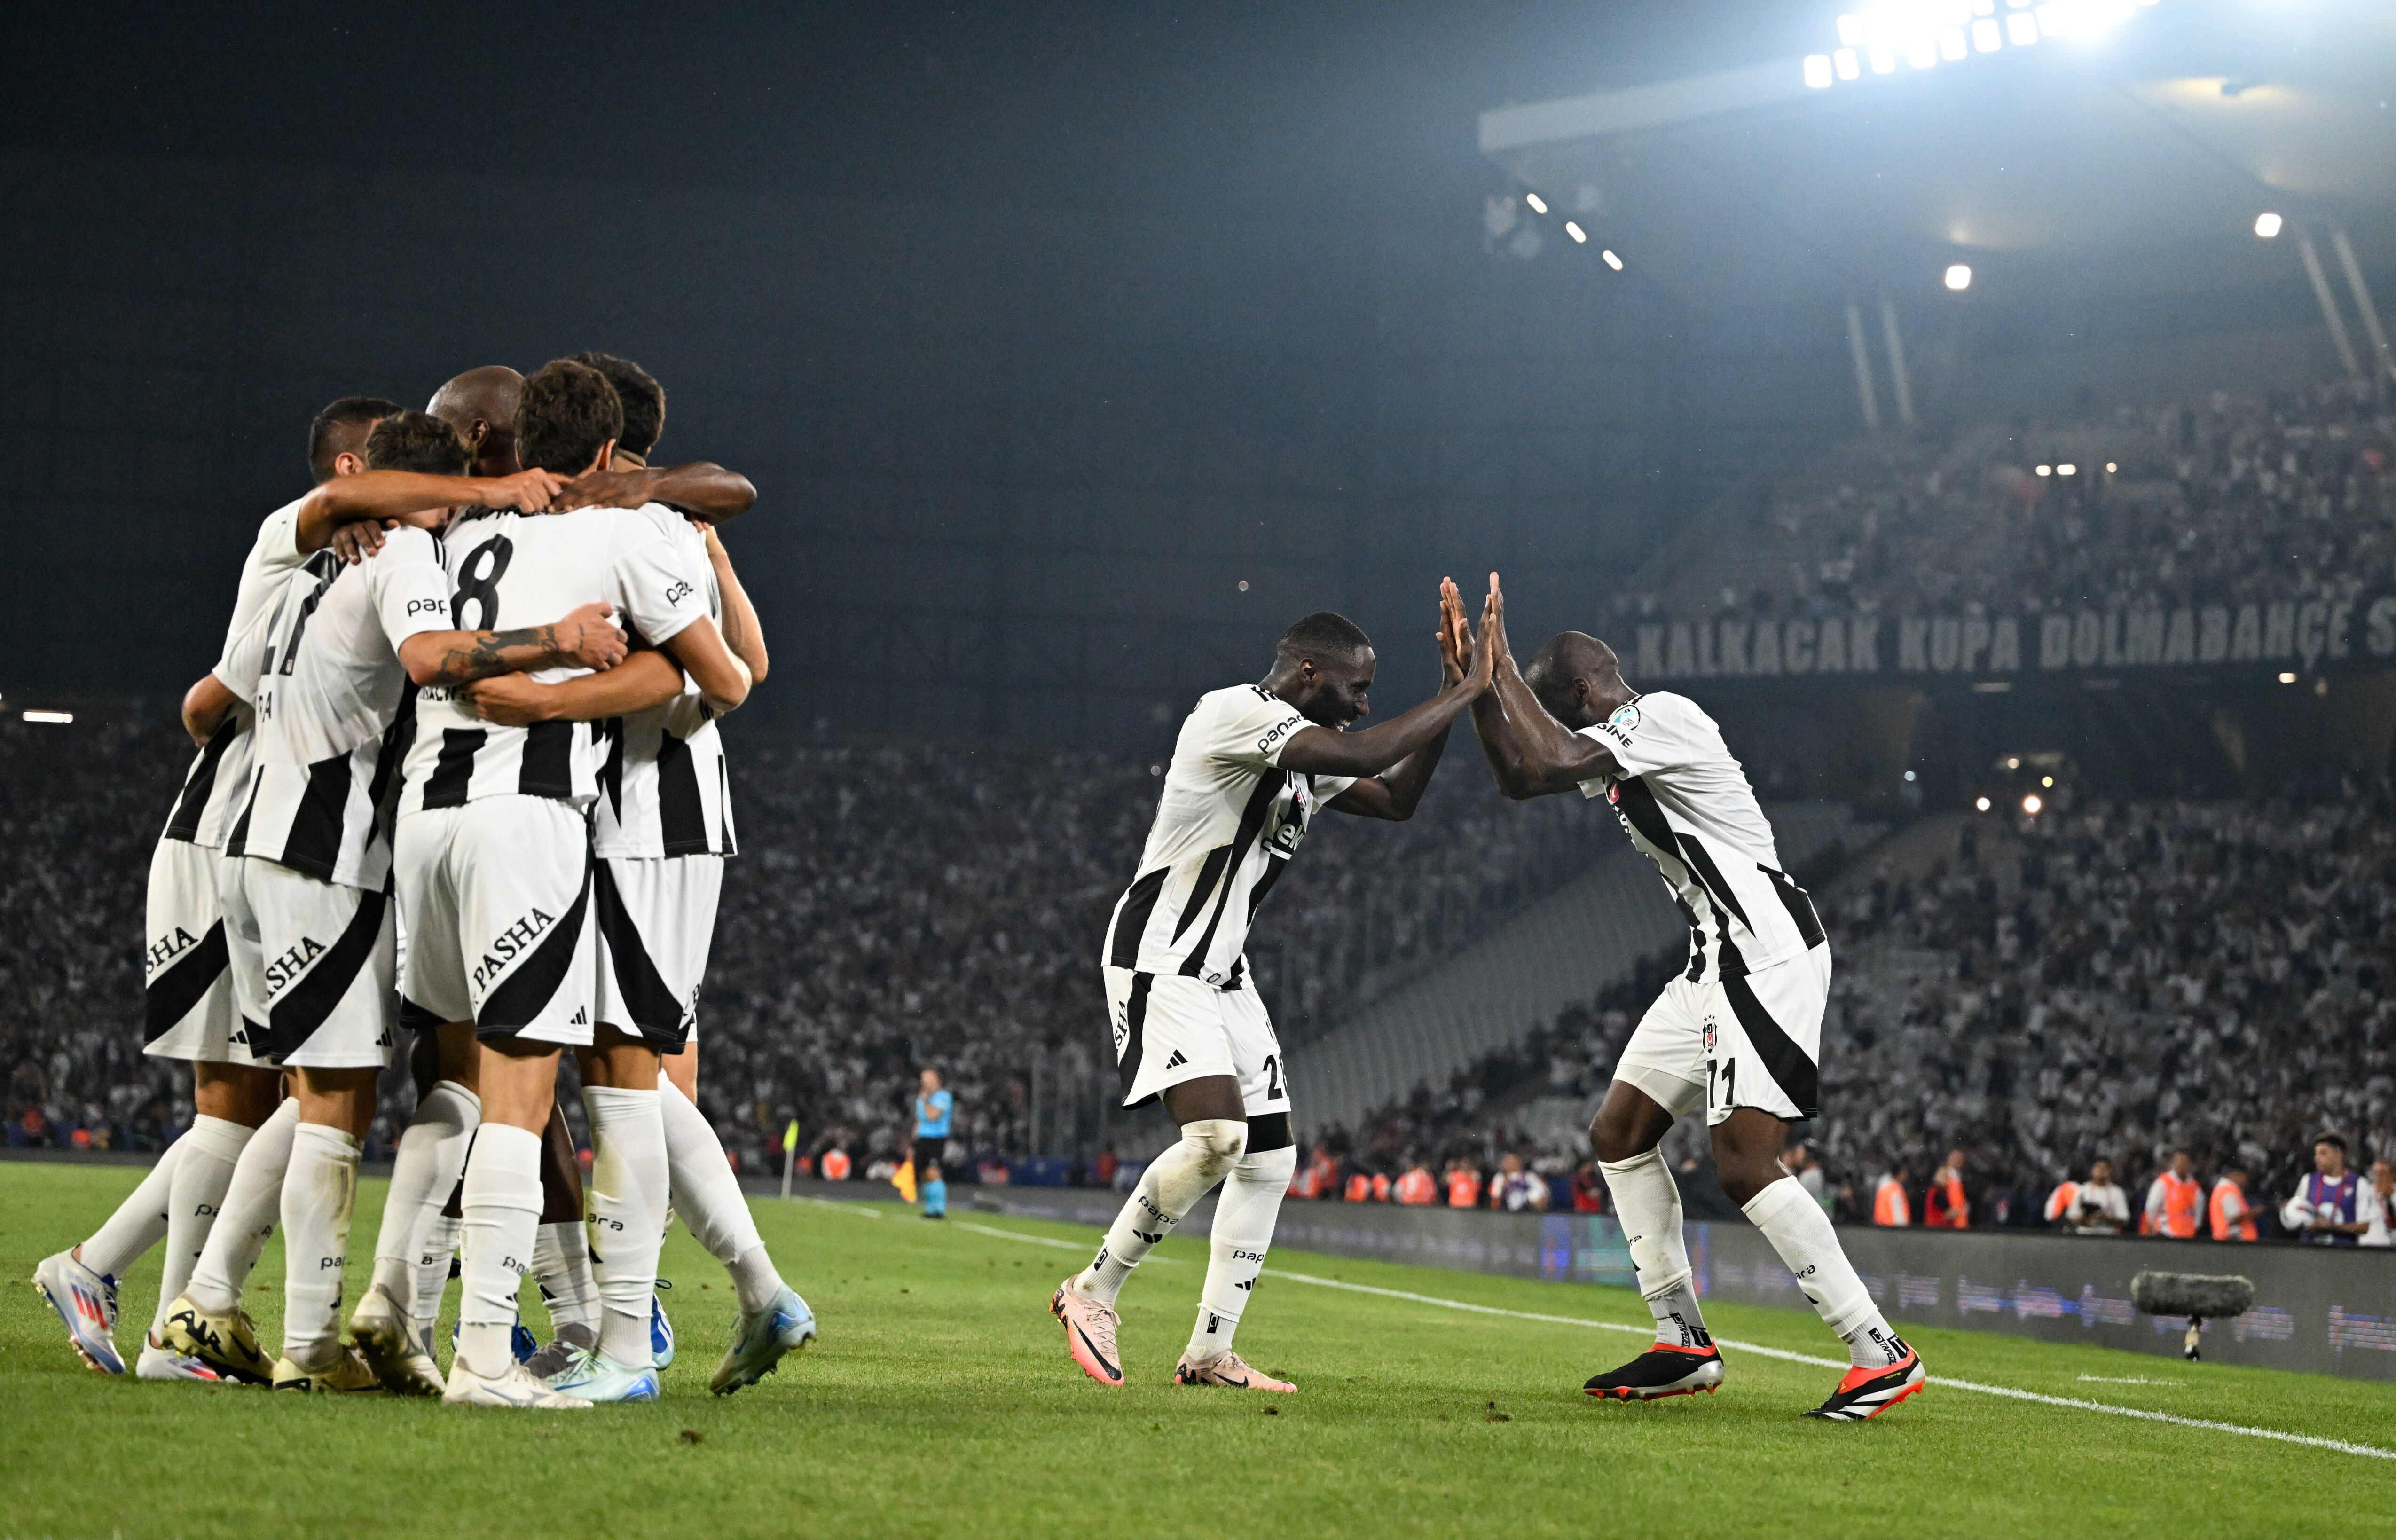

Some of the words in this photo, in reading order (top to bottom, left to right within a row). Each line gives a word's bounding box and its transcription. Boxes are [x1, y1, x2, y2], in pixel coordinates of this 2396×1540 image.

[451, 533, 513, 630] 8
[1898, 616, 2020, 671] KUPA
[473, 911, 556, 993] PASHA
